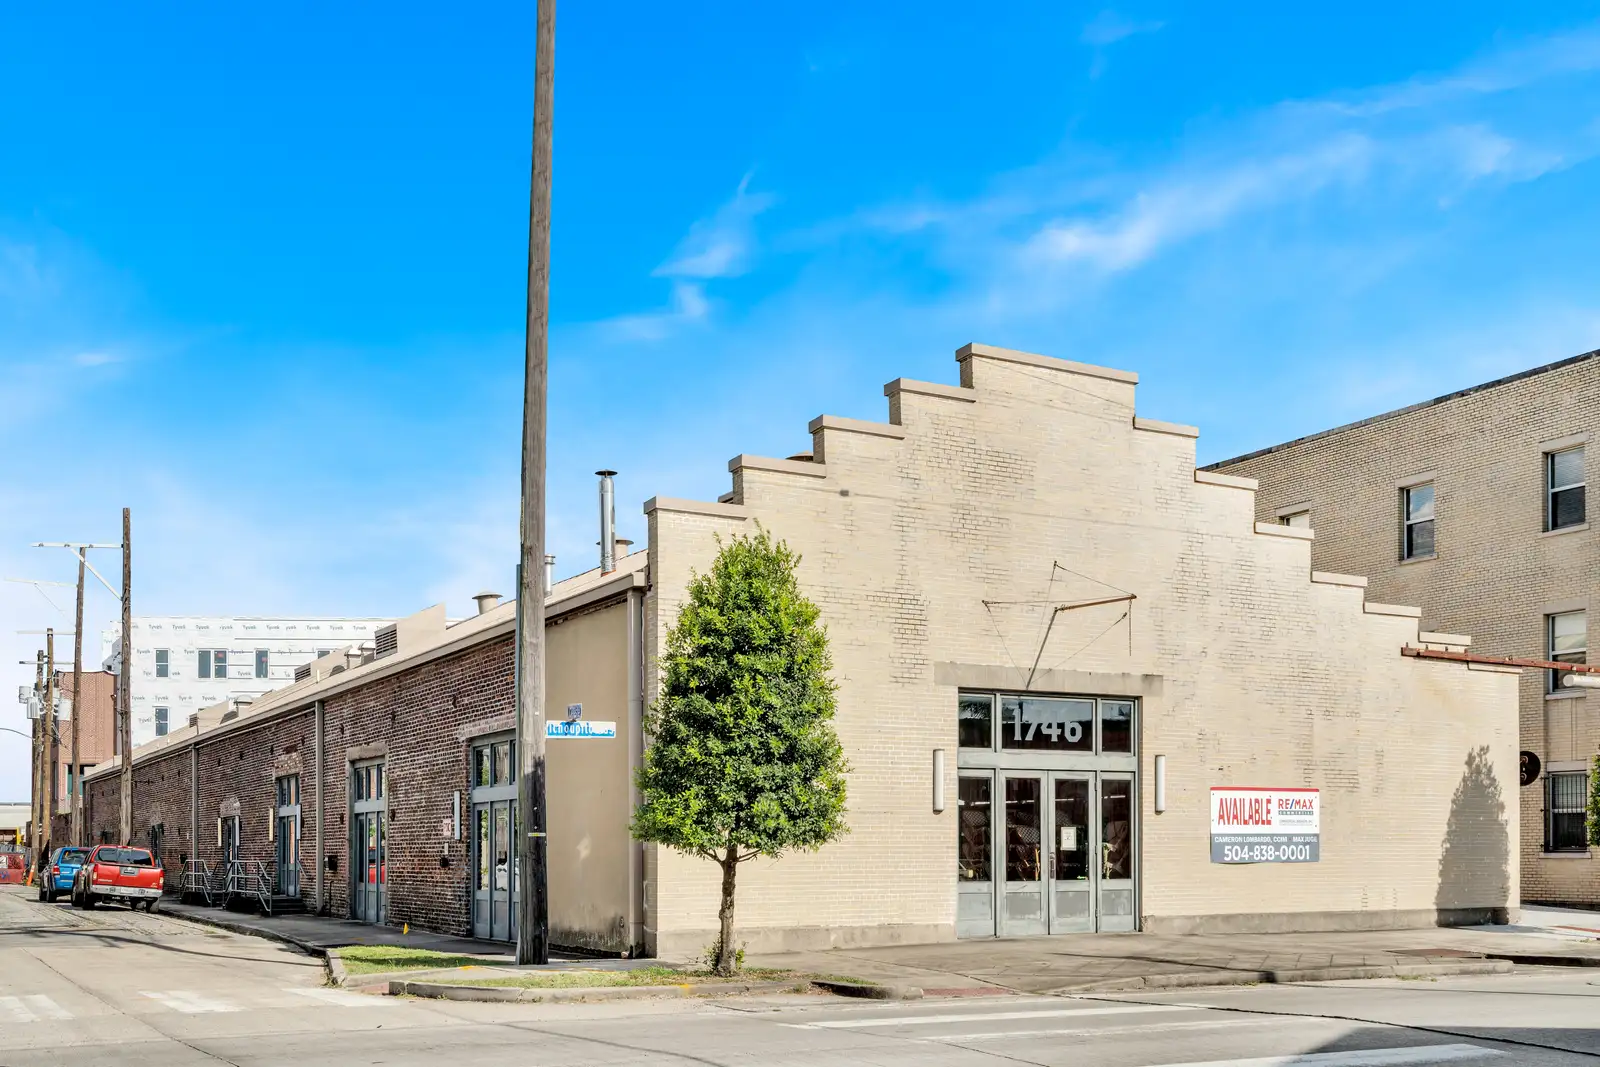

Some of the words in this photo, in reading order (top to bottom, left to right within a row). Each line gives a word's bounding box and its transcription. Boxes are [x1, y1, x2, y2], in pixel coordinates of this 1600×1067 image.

[1012, 707, 1083, 743] 1746
[1218, 797, 1272, 826] AVAILABLE
[1278, 798, 1314, 810] RE/MAX
[1224, 845, 1310, 861] 504-838-0001
